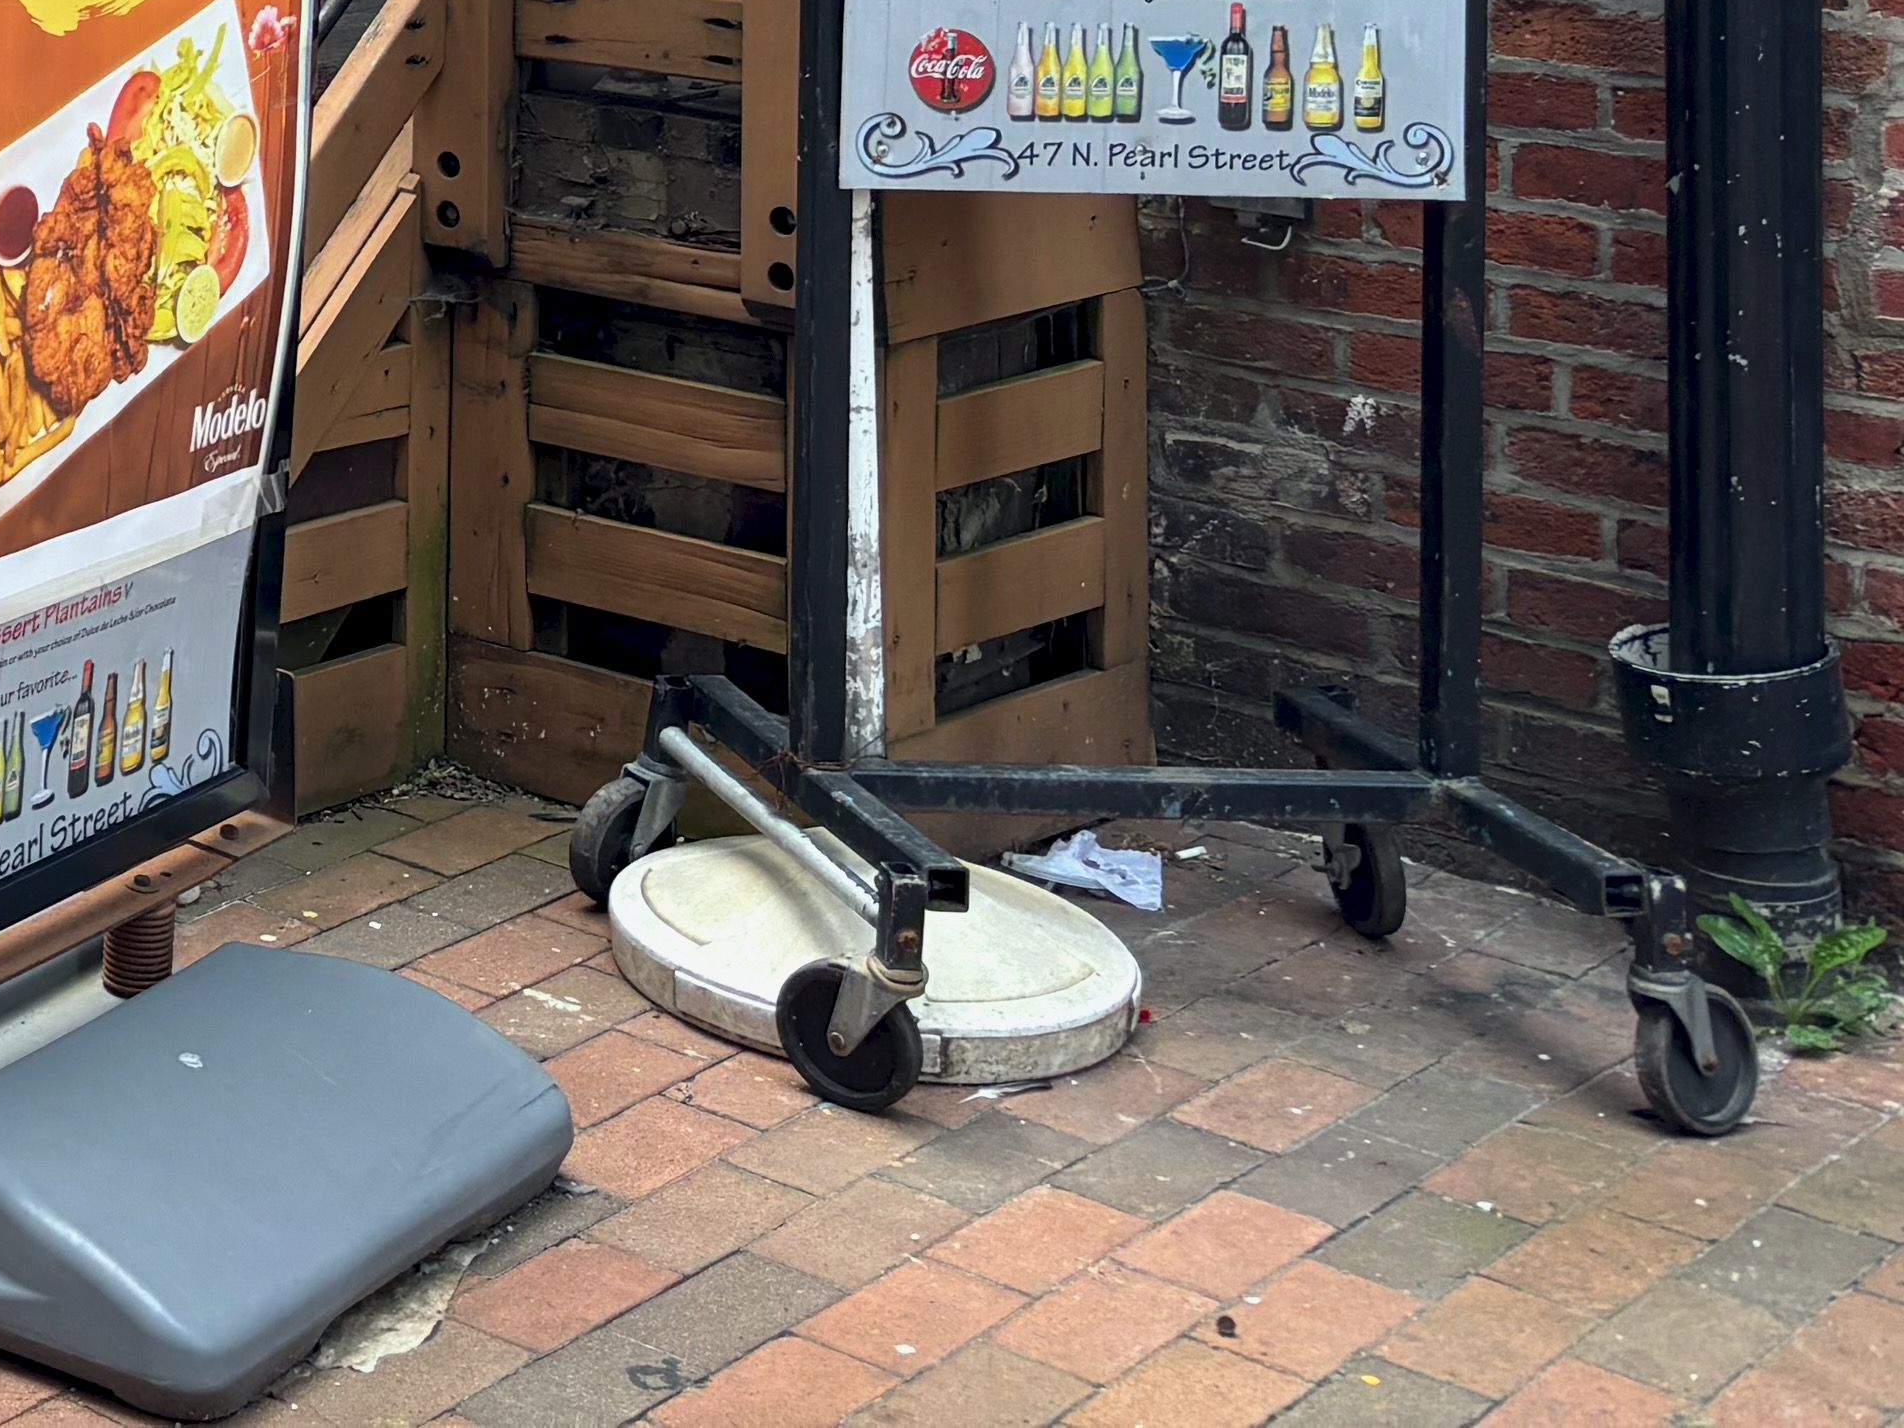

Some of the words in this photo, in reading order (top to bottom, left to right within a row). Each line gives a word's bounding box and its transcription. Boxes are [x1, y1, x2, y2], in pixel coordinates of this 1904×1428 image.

[1017, 141, 1064, 169] 47
[1071, 143, 1099, 168] N.
[1107, 143, 1179, 169] Pearl
[1188, 143, 1292, 172] Street
[189, 395, 266, 453] Modelo
[44, 584, 122, 630] Plantains
[50, 791, 136, 858] Street
